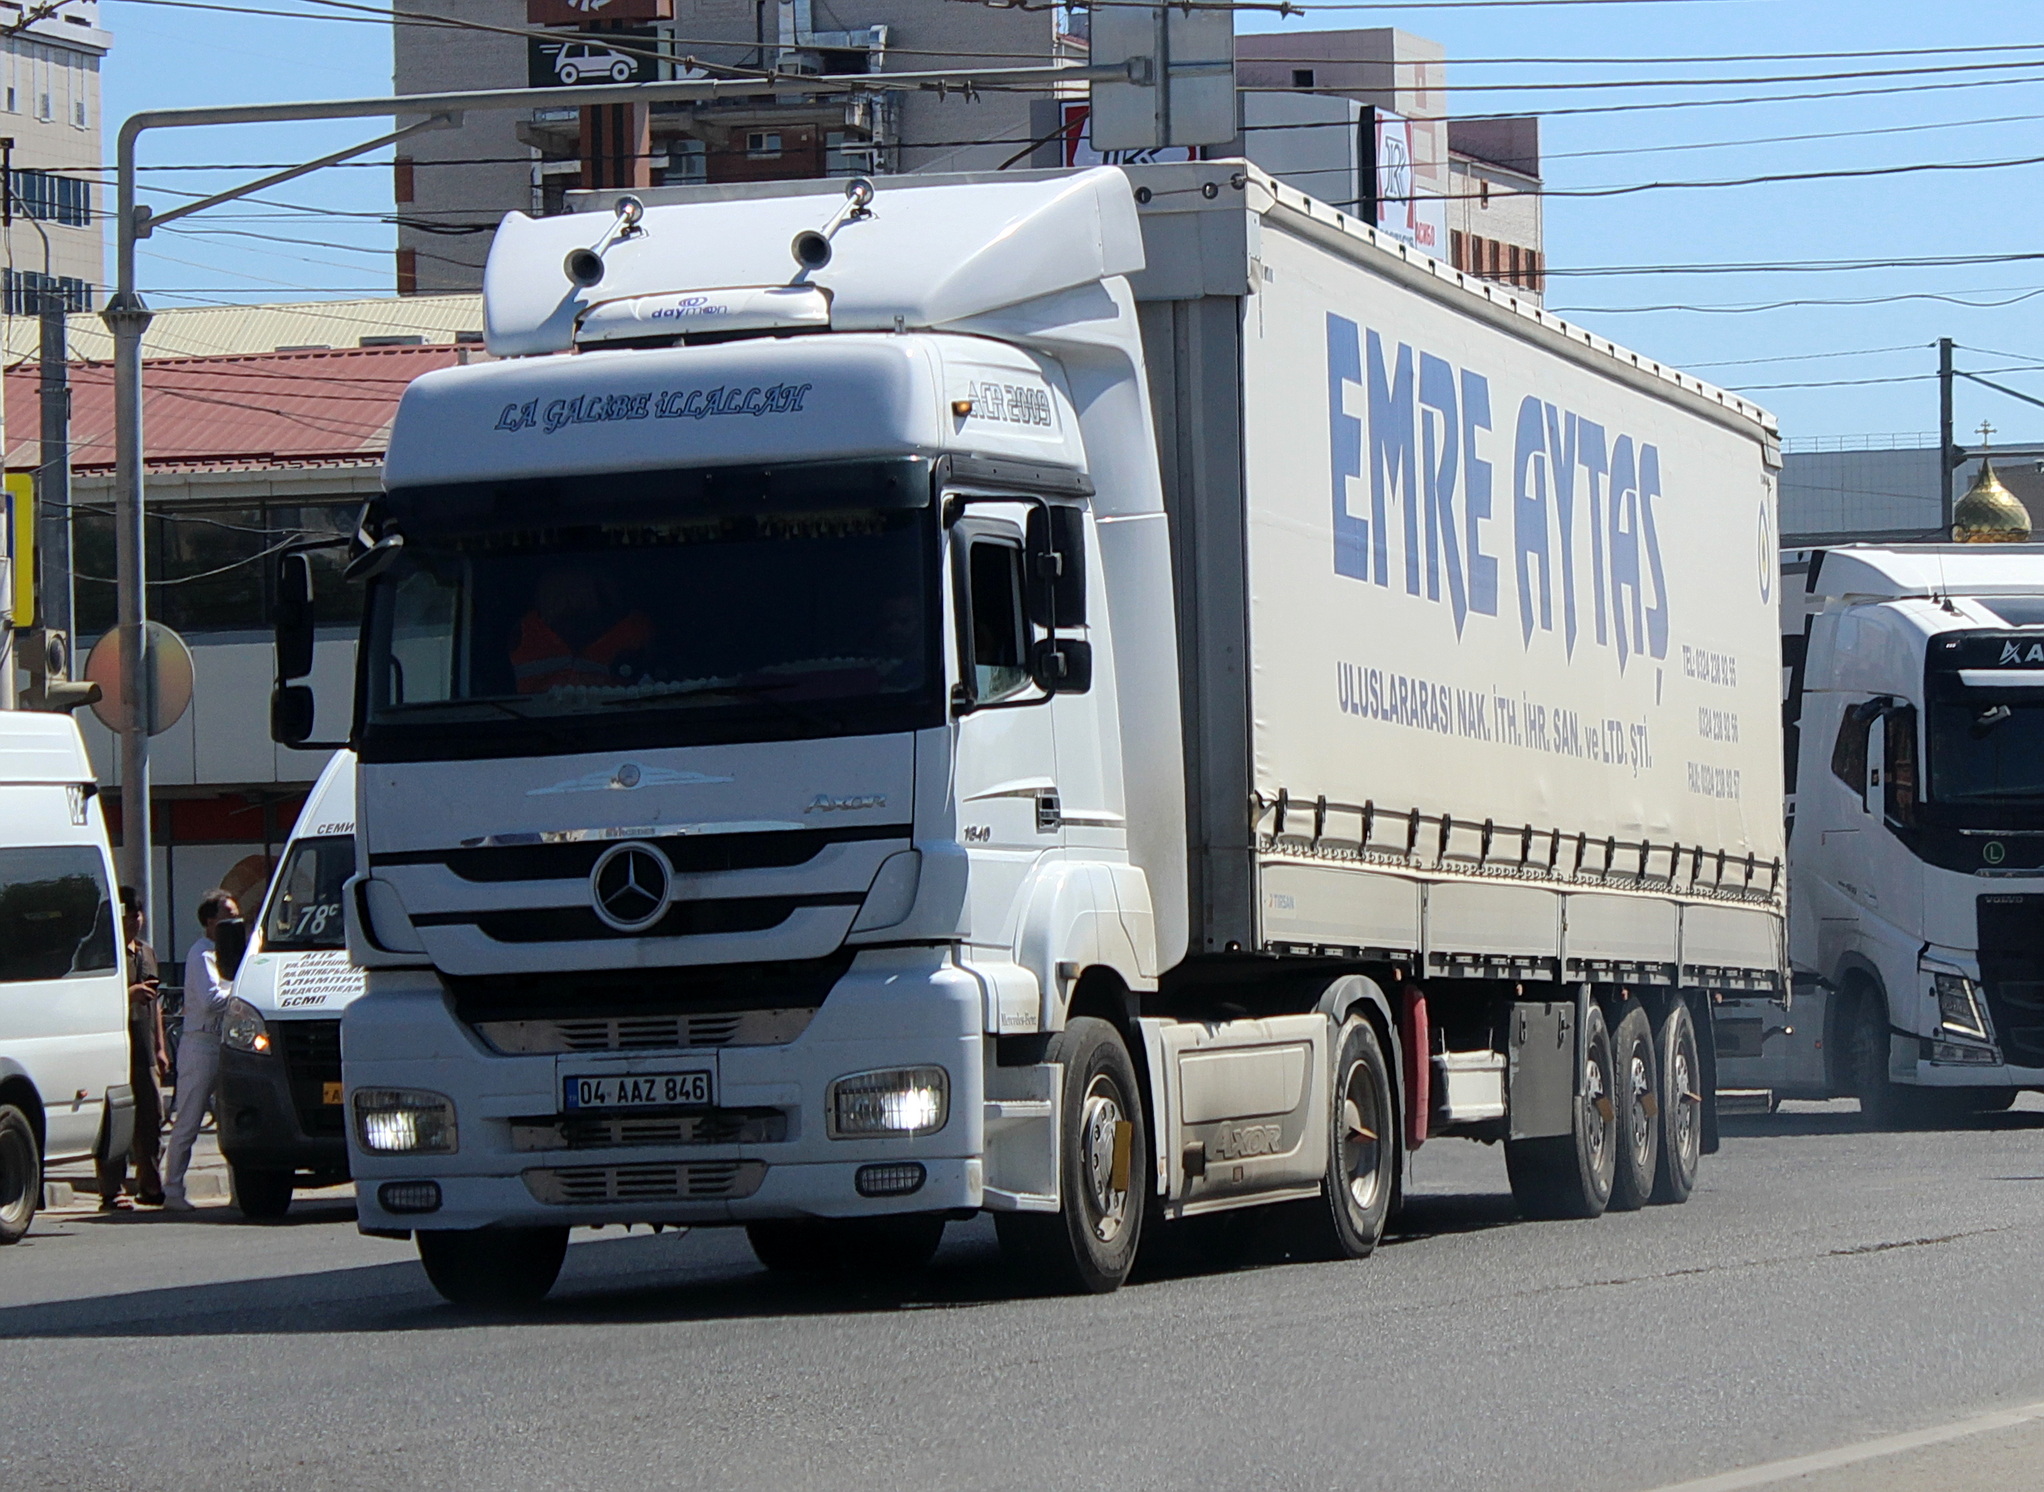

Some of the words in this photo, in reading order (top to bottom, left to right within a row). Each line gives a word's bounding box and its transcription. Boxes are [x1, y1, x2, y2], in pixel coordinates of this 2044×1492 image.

[494, 397, 539, 432] LA
[1003, 385, 1052, 427] 2009
[1326, 311, 1498, 646] EMRE
[1513, 394, 1669, 706] AYTAŞ
[1682, 645, 1695, 677] TEL:
[1729, 656, 1736, 688] 55
[1337, 661, 1453, 735] ULUSLARARASI
[1456, 688, 1491, 742] NAK.
[1493, 684, 1521, 746] İTH.
[1523, 690, 1550, 751] İHR.
[1553, 707, 1582, 758] SAN.
[1584, 725, 1598, 761] ve
[1601, 718, 1628, 765] LTD.
[1630, 714, 1652, 778] ŞTİ.
[317, 822, 354, 834] СЕМИ
[964, 826, 990, 842] 1840
[280, 976, 364, 988] АЛИМПИК
[280, 985, 365, 997] МЕДКОЛЛЕДЖ
[281, 995, 327, 1008] БСМП
[580, 1081, 605, 1104] 04
[617, 1079, 656, 1103] AAZ
[665, 1076, 705, 1101] 846
